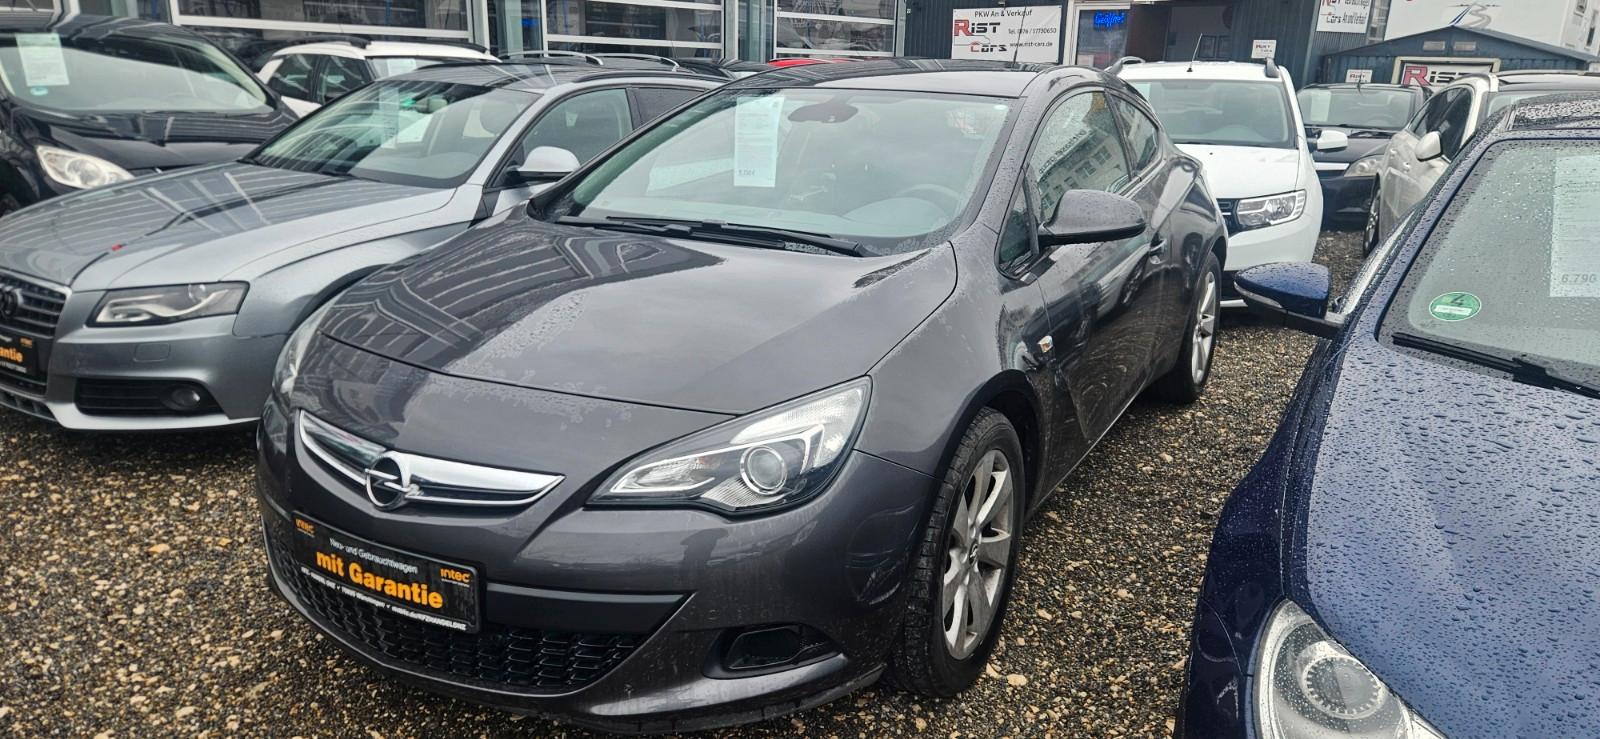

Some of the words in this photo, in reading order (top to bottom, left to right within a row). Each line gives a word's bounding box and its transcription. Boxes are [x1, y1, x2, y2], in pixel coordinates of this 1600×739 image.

[974, 10, 989, 18] PKW
[1006, 9, 1033, 17] Verkauf
[316, 551, 345, 577] mit
[348, 562, 443, 608] Garantie
